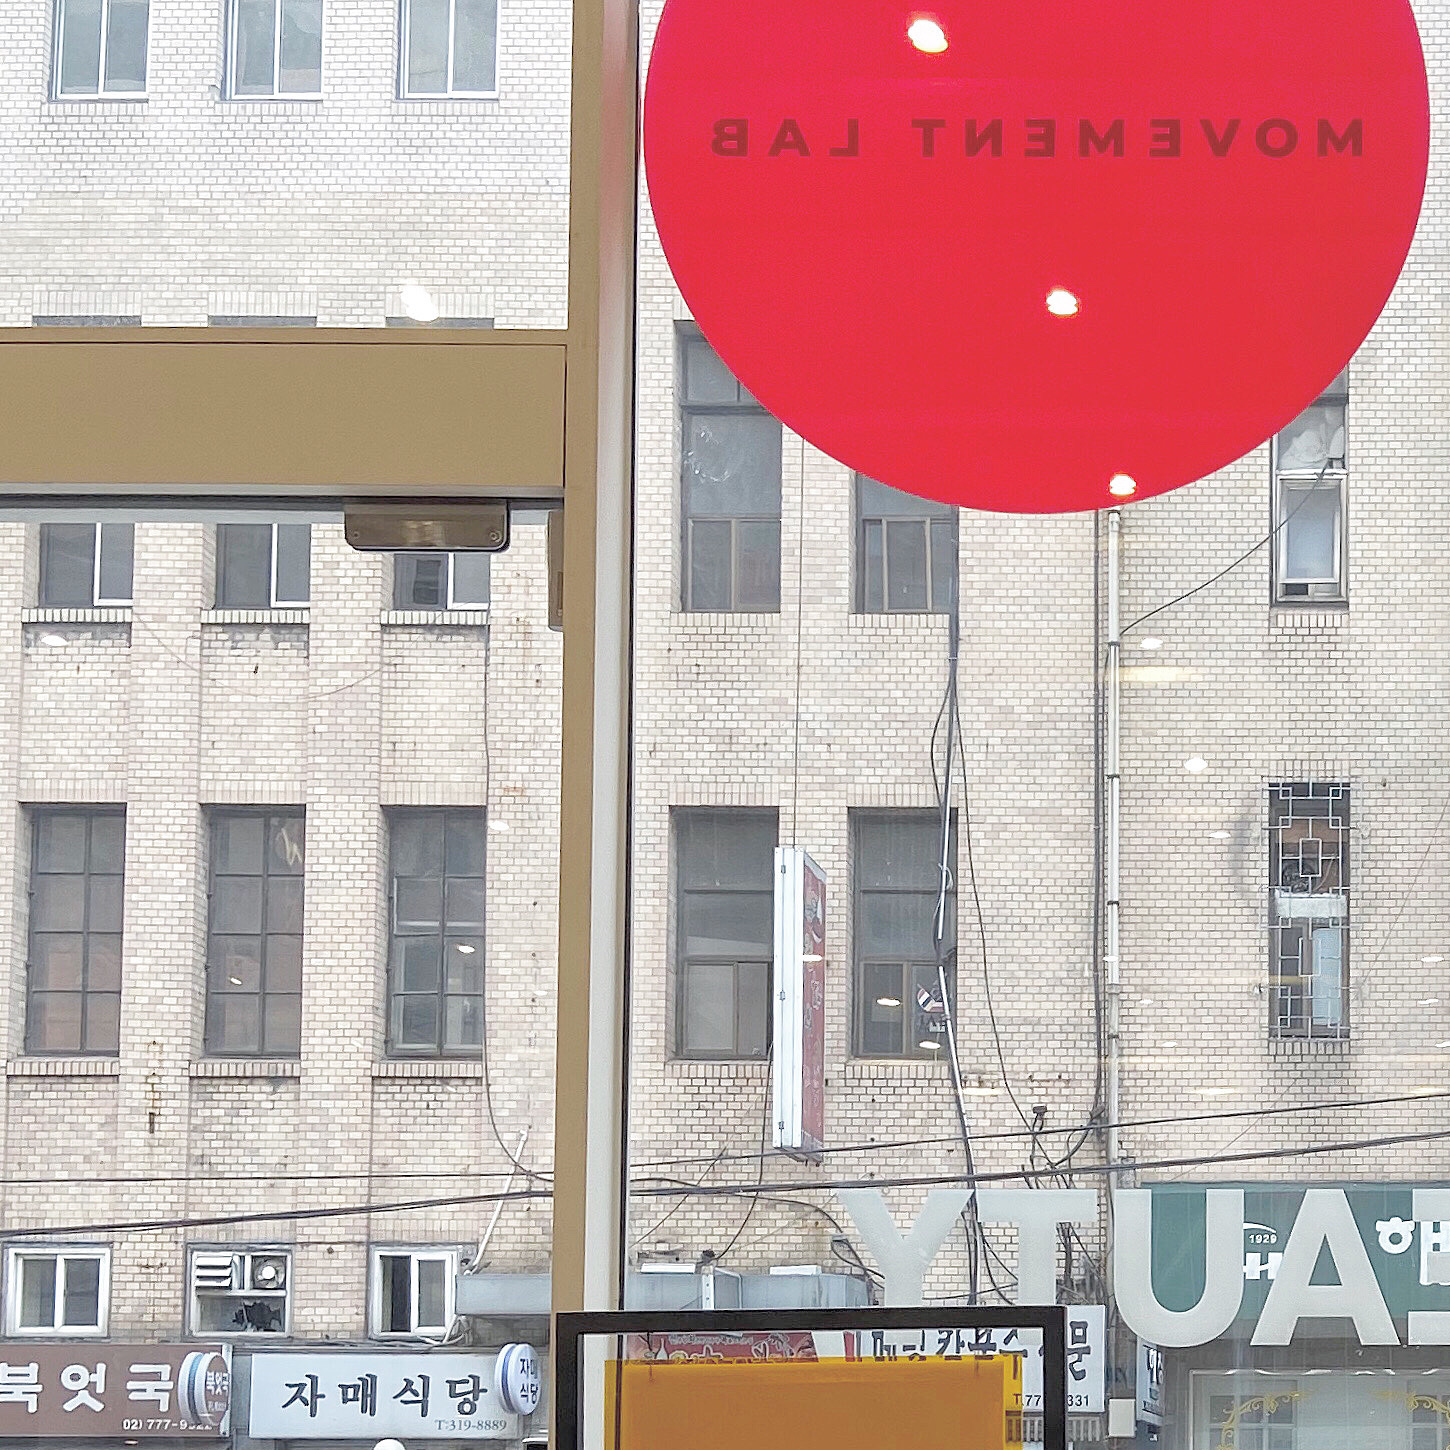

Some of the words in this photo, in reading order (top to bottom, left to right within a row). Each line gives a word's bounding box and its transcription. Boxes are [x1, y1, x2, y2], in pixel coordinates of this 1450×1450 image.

[1249, 1234, 1278, 1245] 1929
[0, 1362, 174, 1413] 북엇국
[281, 1373, 489, 1418] 자매식당
[122, 1419, 143, 1431] 02)
[434, 1419, 508, 1432] T:319-8889
